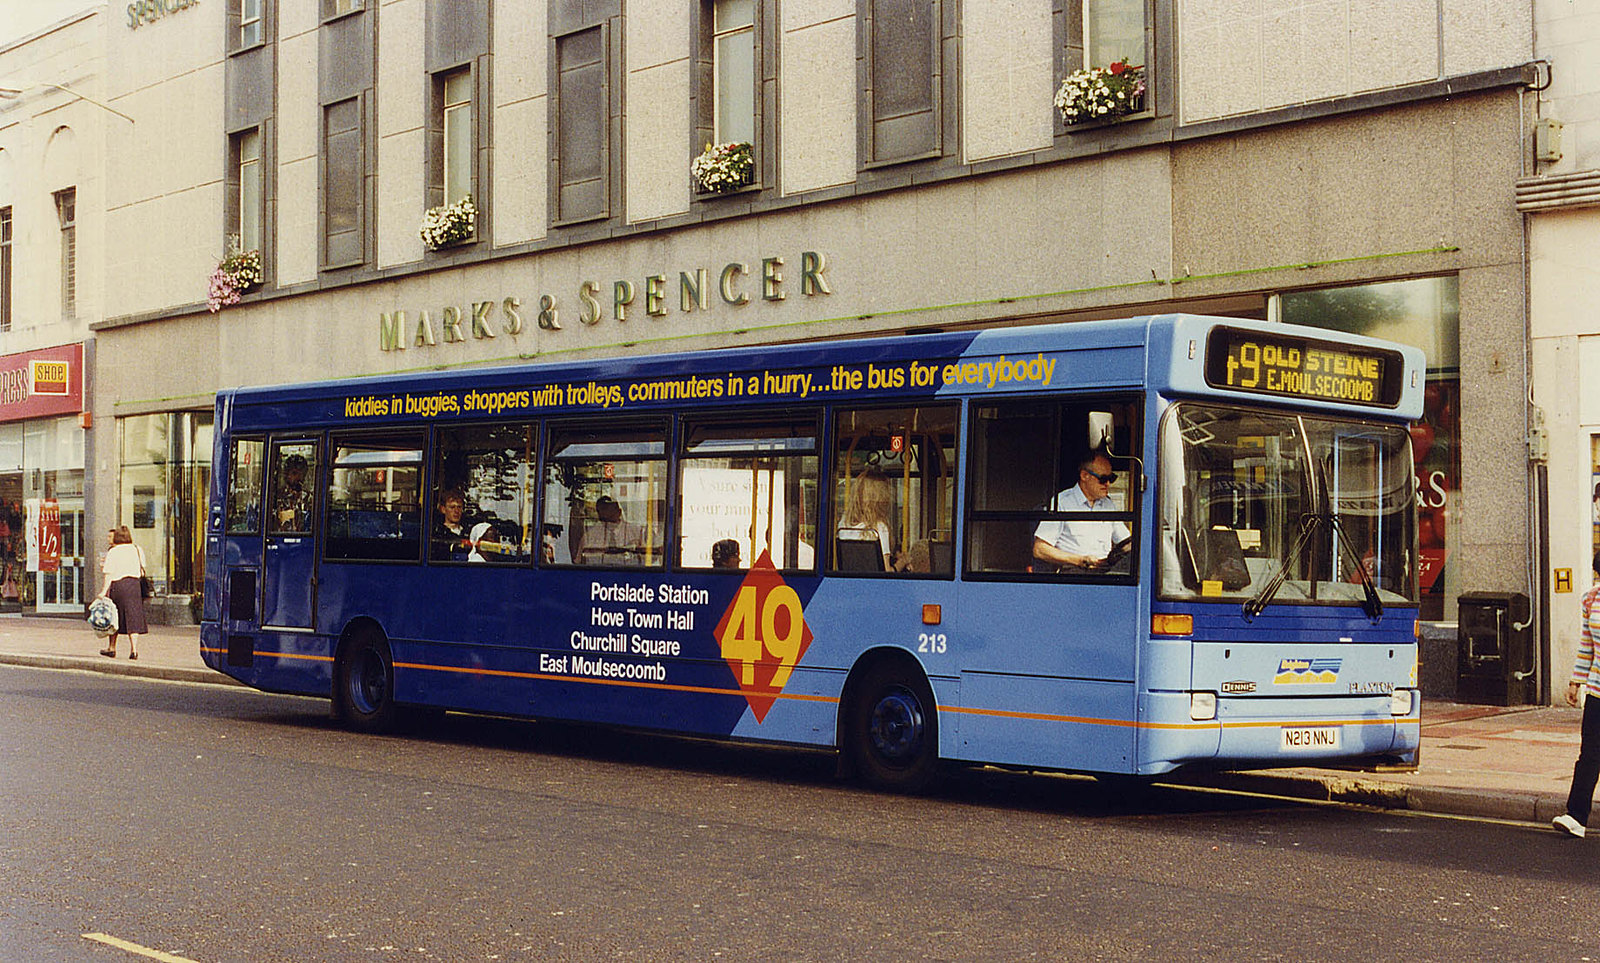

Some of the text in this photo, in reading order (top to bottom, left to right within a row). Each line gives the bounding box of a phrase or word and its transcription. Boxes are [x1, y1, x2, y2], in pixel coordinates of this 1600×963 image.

[127, 0, 200, 30] SPENC
[379, 251, 831, 351] MARKS & SPENCER
[1262, 344, 1379, 379] OLD STEINE
[344, 396, 389, 417] kiddies
[391, 394, 403, 415] in
[405, 391, 461, 417] buggies,
[463, 389, 530, 414] shoppers
[532, 384, 564, 407] with
[566, 381, 625, 409] trolleys,
[628, 375, 724, 402] commuters
[727, 372, 744, 396] in
[747, 376, 760, 395] a
[867, 363, 905, 389] bus
[909, 360, 939, 387] for
[941, 352, 1057, 389] everybody
[1266, 369, 1374, 401] E.MOULSECOOMB
[591, 582, 709, 605] Portslade Station
[1556, 570, 1570, 590] H
[591, 607, 694, 631] Hove Town Hall
[570, 630, 681, 658] Churchill Square
[720, 585, 804, 688] 49
[918, 633, 947, 654] 213
[539, 653, 667, 681] East Moulsecoomb
[1221, 681, 1257, 693] DENNIS
[1349, 682, 1394, 694] PLAXTON
[1285, 730, 1336, 746] N213 NNJ
